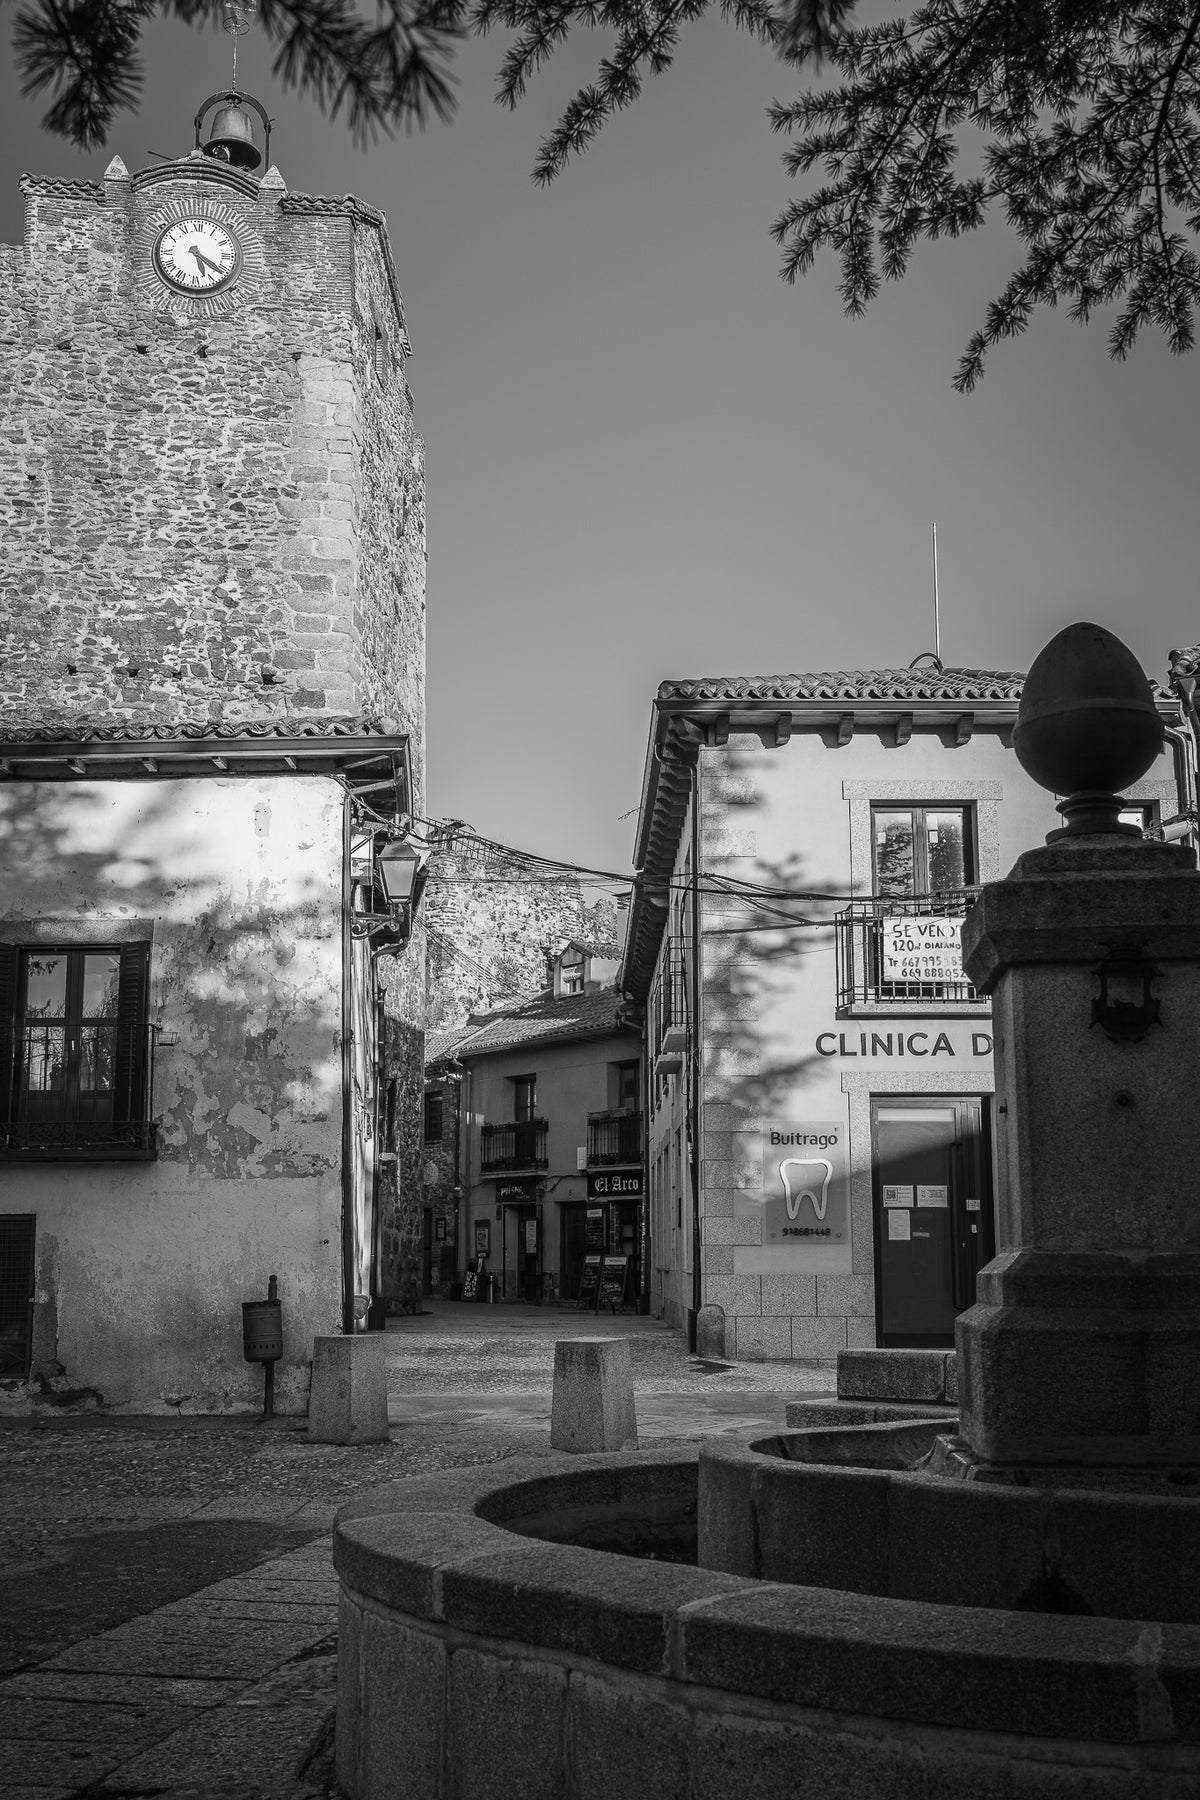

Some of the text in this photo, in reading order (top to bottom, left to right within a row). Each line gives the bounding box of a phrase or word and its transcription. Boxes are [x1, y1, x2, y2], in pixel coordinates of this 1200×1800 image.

[893, 924, 961, 938] SE VEND
[815, 1032, 955, 1056] CLINICA
[770, 1131, 838, 1150] Buitrago
[595, 1176, 639, 1192] El Arco
